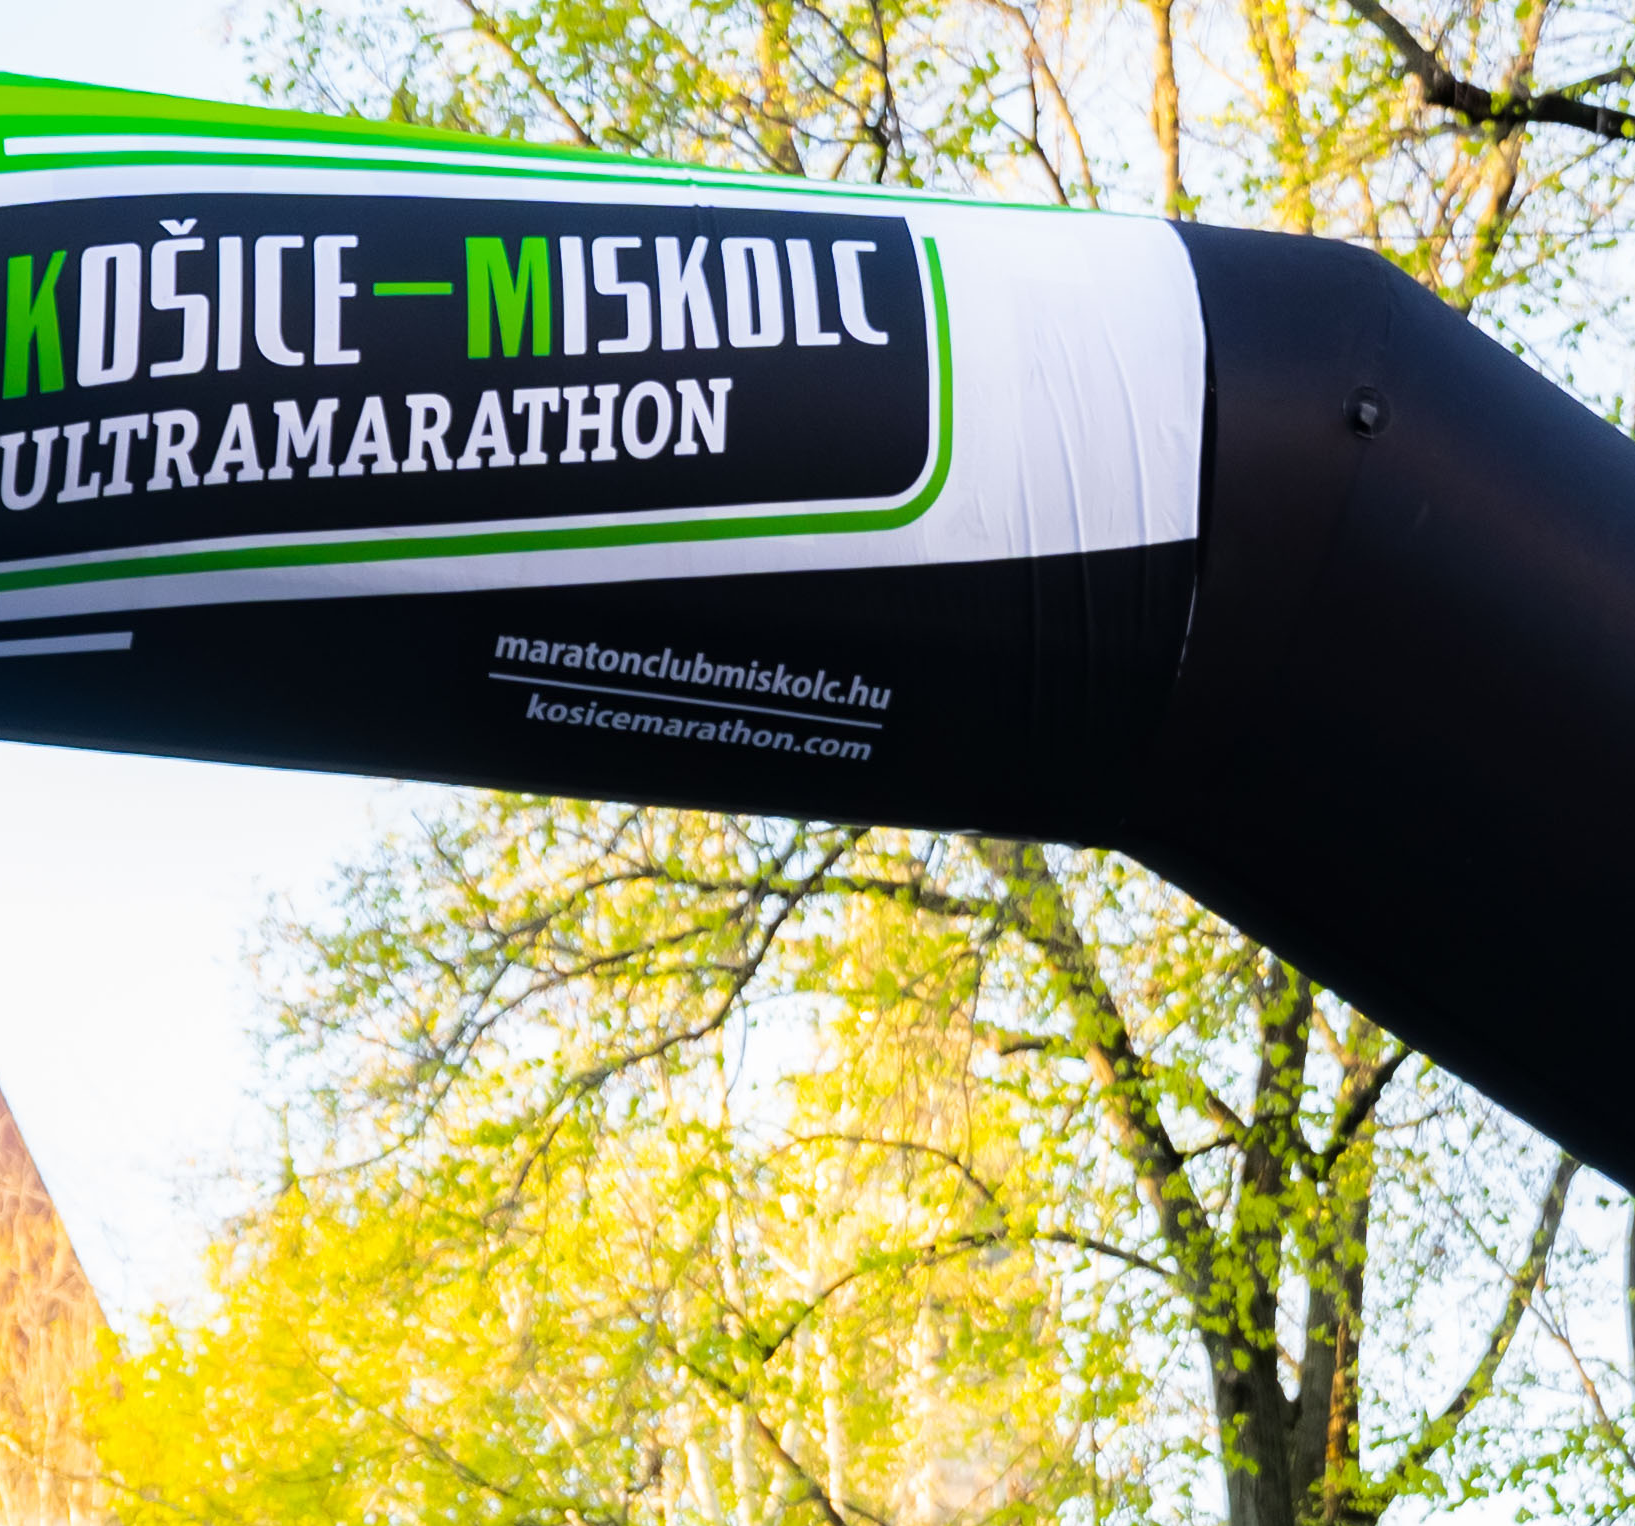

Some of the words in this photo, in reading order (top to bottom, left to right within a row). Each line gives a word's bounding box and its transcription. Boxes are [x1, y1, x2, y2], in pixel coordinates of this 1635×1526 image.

[2, 219, 361, 402] KOŠICE
[464, 237, 890, 360] MISKOLC
[494, 635, 891, 711] maratonclubmiskolc.hu
[526, 694, 872, 761] kosicemarathon.com
